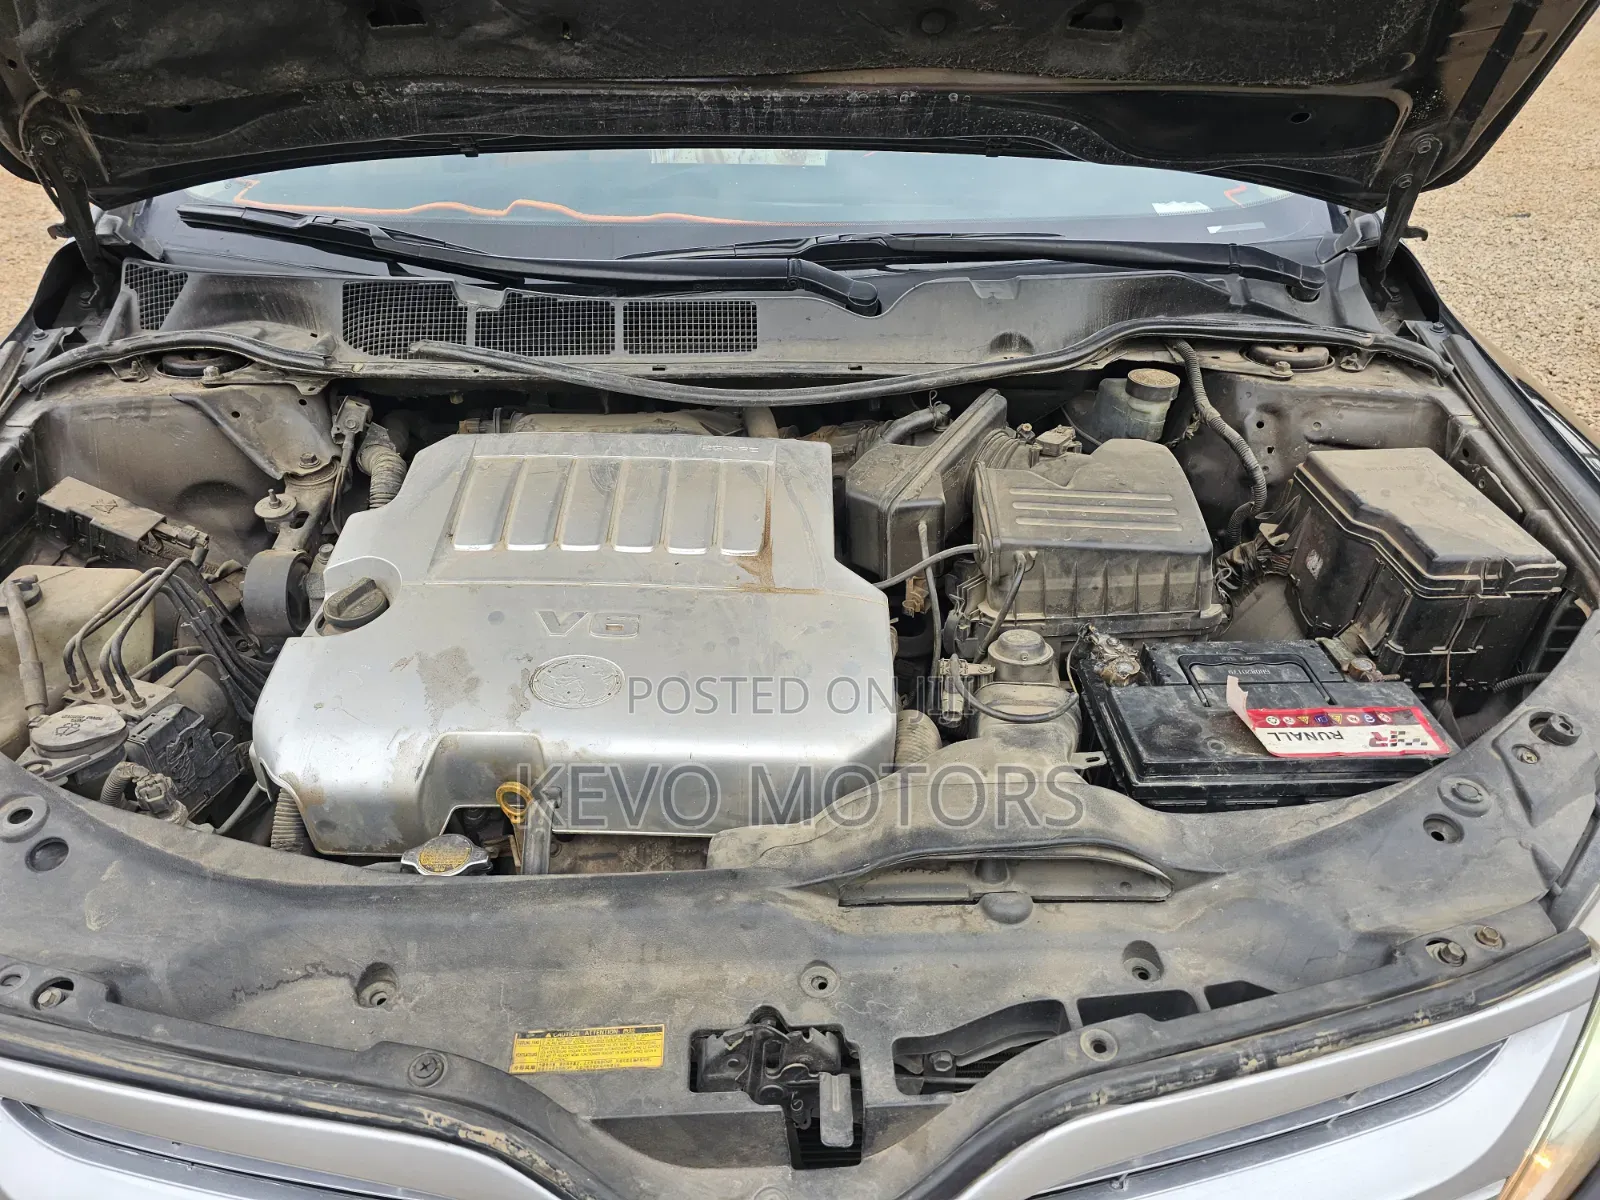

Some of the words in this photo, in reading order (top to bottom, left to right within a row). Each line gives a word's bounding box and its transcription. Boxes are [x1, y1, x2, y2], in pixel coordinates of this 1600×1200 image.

[534, 610, 641, 639] V6
[1266, 730, 1344, 742] RUNALL
[552, 1030, 580, 1038] CAUTION
[584, 1028, 618, 1036] ATTENTION
